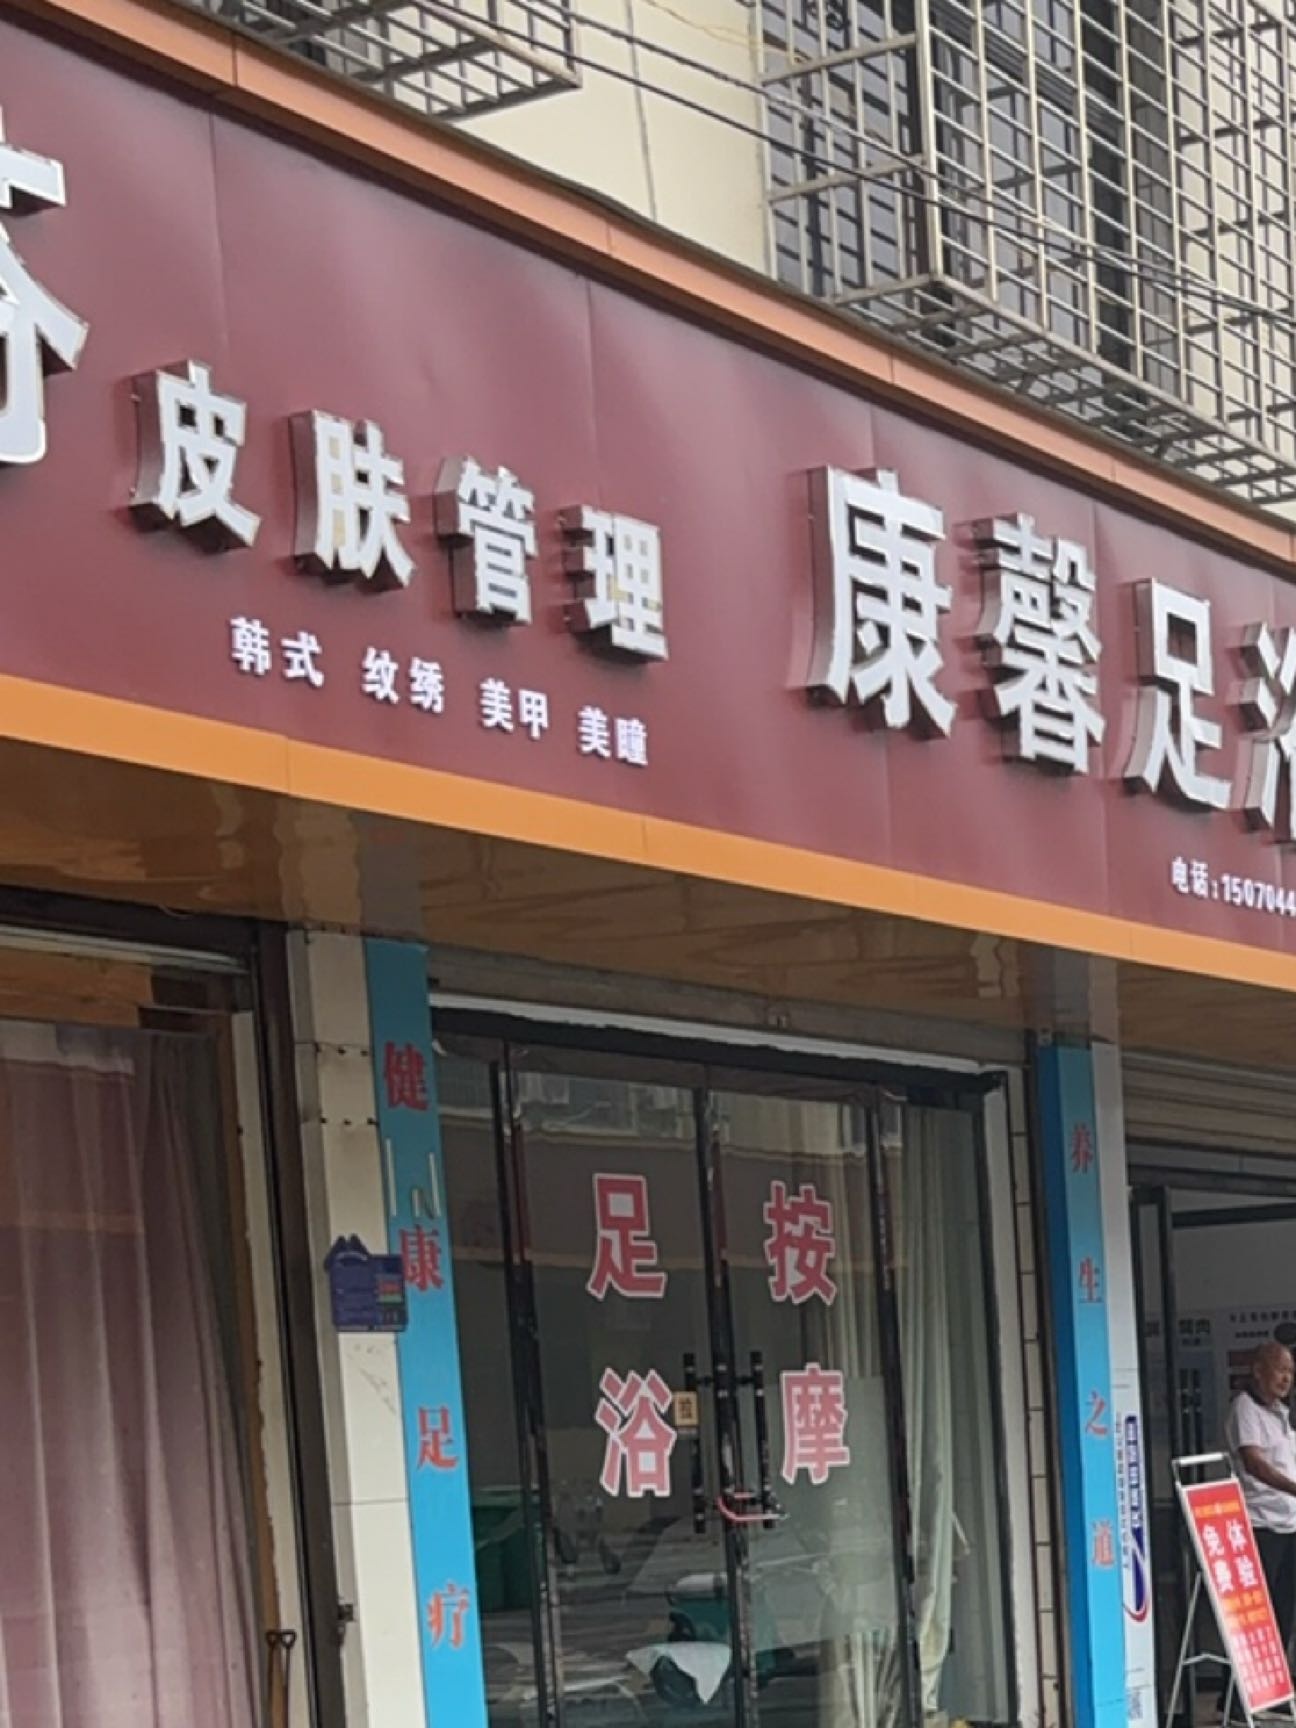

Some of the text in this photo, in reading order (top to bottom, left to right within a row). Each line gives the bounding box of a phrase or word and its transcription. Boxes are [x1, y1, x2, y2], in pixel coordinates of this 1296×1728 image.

[153, 361, 669, 661] 皮肤管理
[230, 616, 649, 767] 韩式 纹绣 美甲 美瞳
[382, 1041, 471, 1649] 健康足疗
[587, 1172, 676, 1499] 足浴
[763, 1180, 852, 1485] 按摩
[1070, 1123, 1115, 1567] 养生之道
